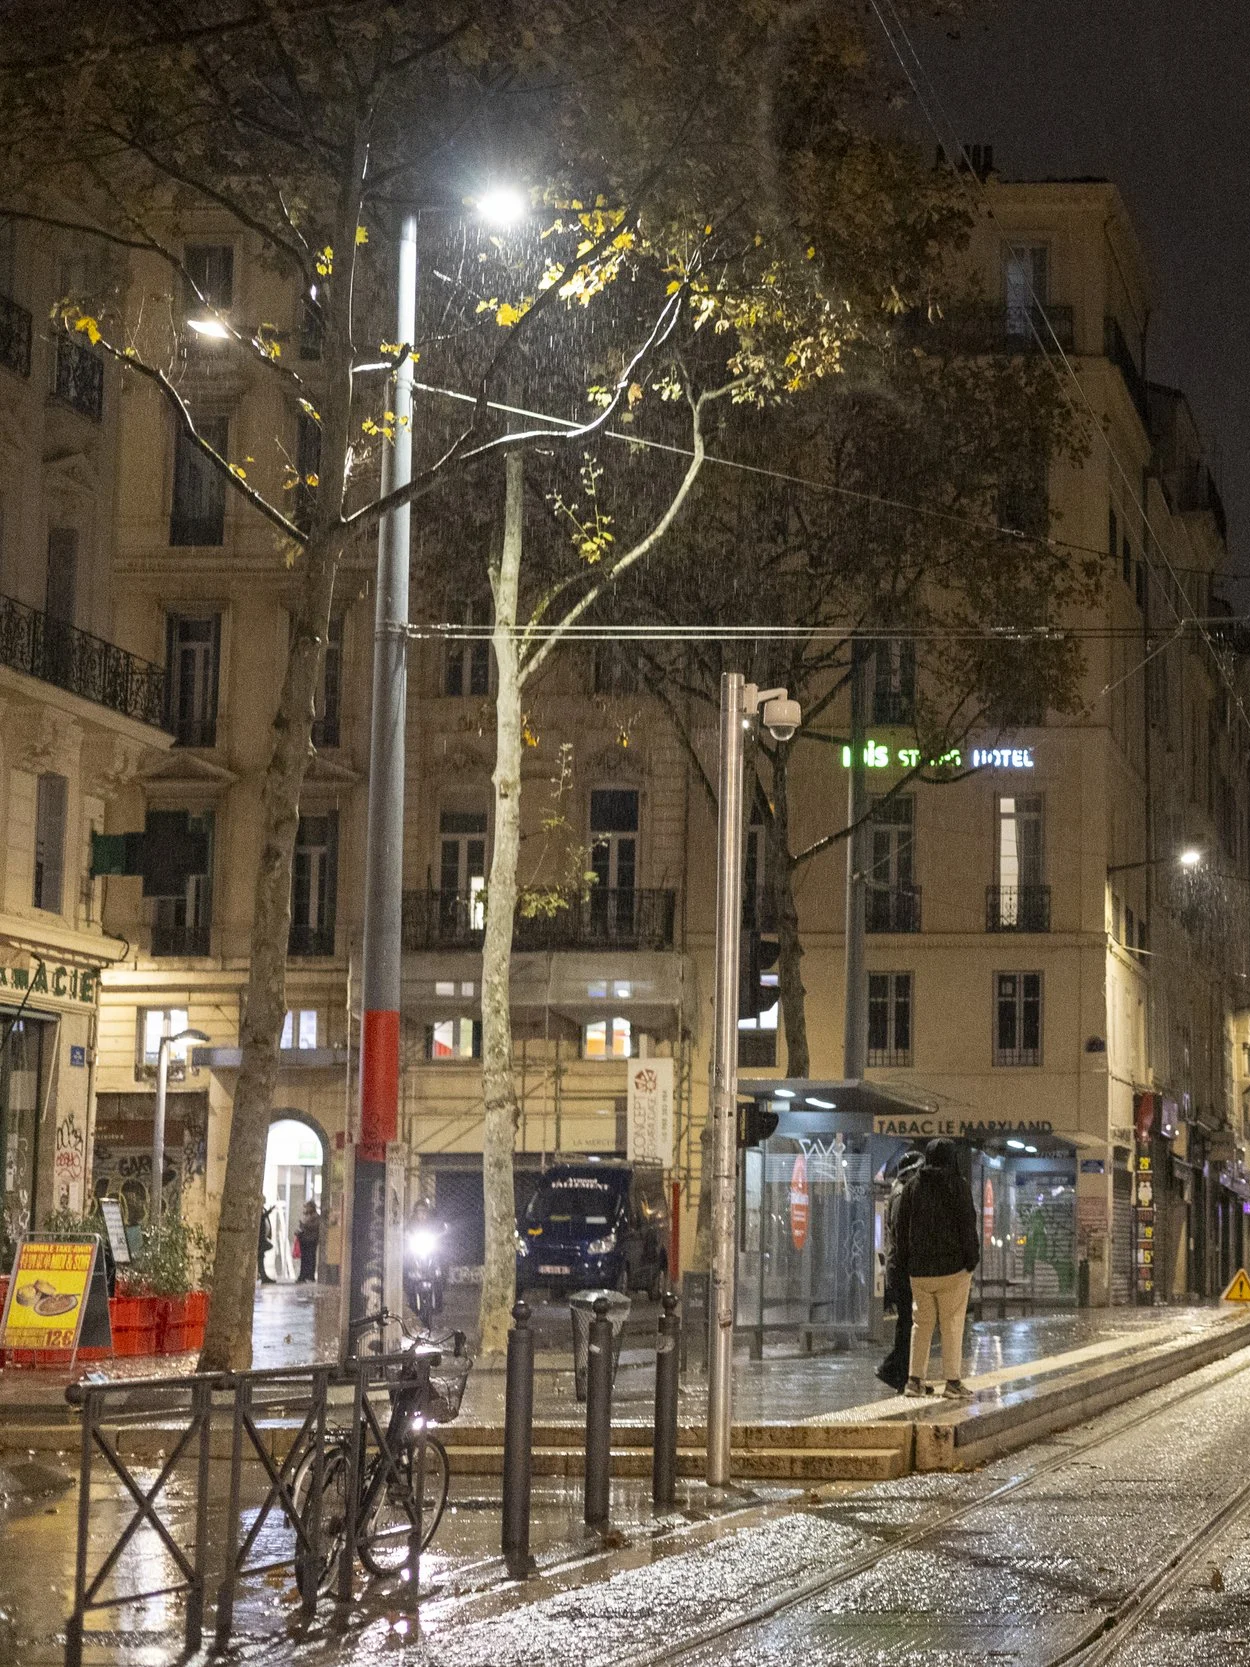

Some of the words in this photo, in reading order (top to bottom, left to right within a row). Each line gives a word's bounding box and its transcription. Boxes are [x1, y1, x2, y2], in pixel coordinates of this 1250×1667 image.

[973, 749, 1034, 768] HOTEL
[878, 1121, 935, 1134] TABAC
[939, 1121, 954, 1134] LE
[960, 1120, 1053, 1135] MARYLAND
